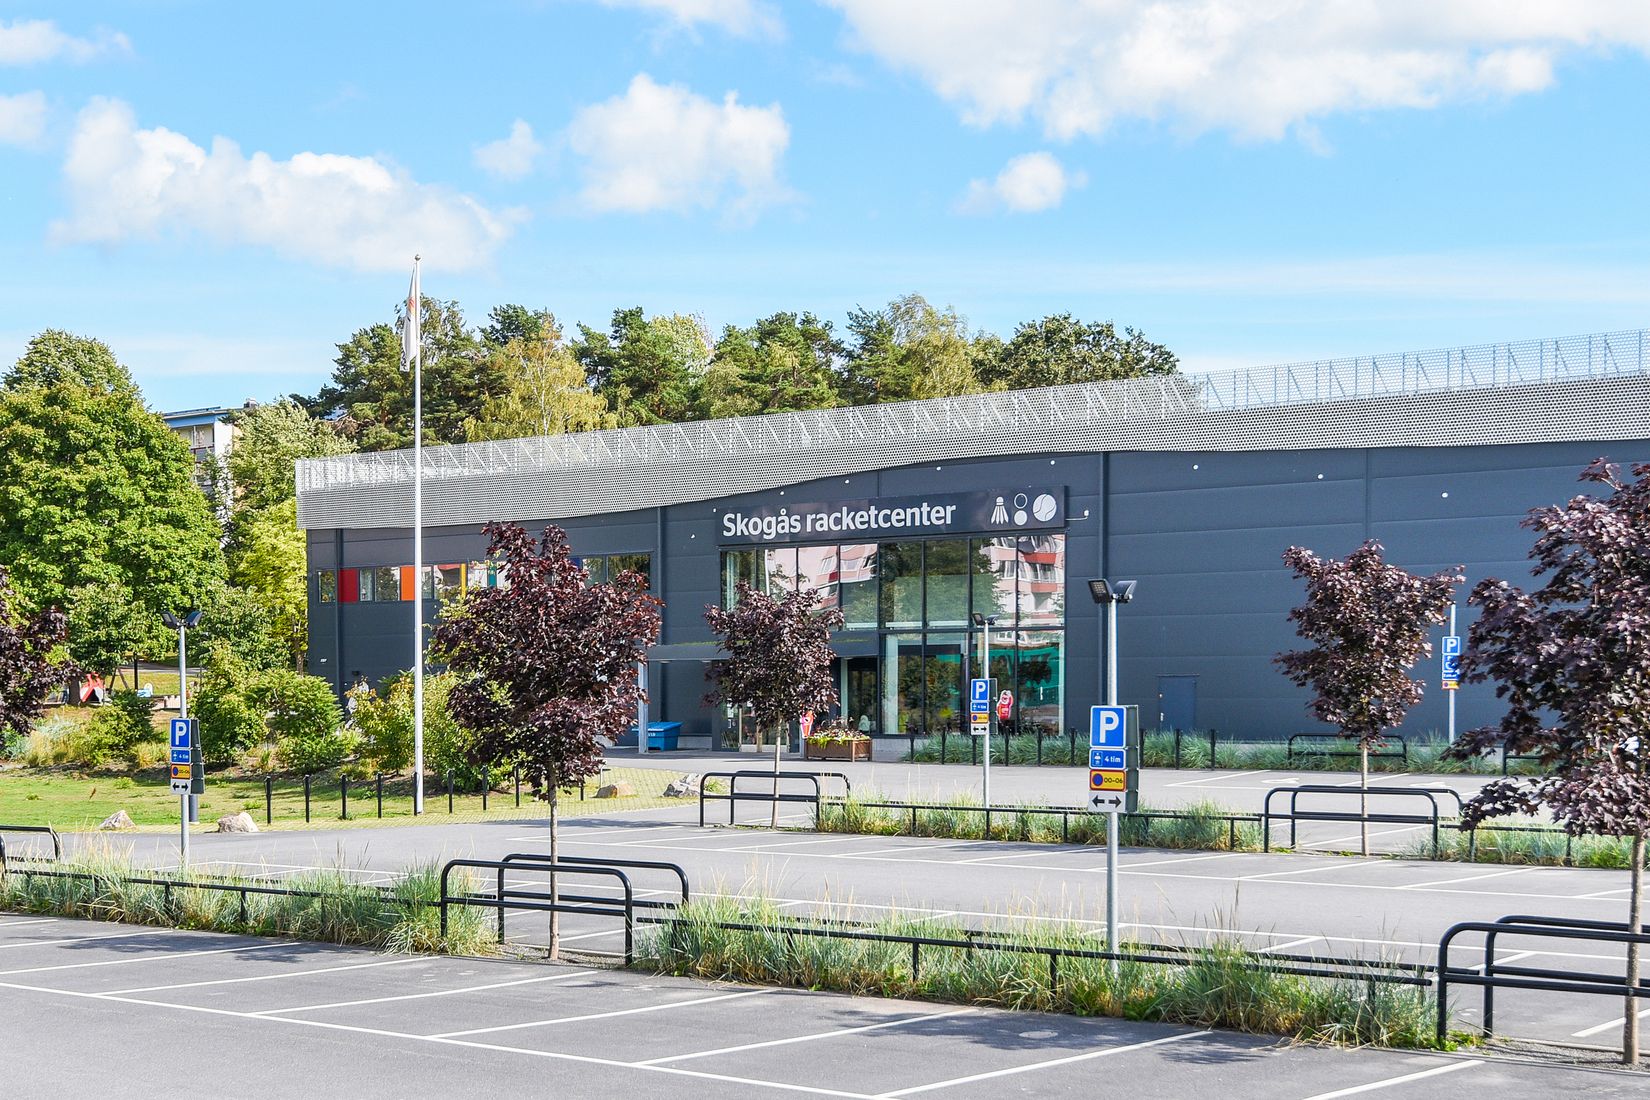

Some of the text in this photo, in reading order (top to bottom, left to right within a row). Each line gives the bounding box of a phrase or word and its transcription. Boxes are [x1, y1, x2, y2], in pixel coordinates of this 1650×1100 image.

[722, 502, 957, 540] Skogås racketcenter
[1446, 638, 1457, 653] P
[975, 681, 987, 699] P
[175, 721, 187, 746] P
[1099, 710, 1120, 744] P
[1104, 755, 1121, 763] 4 tim
